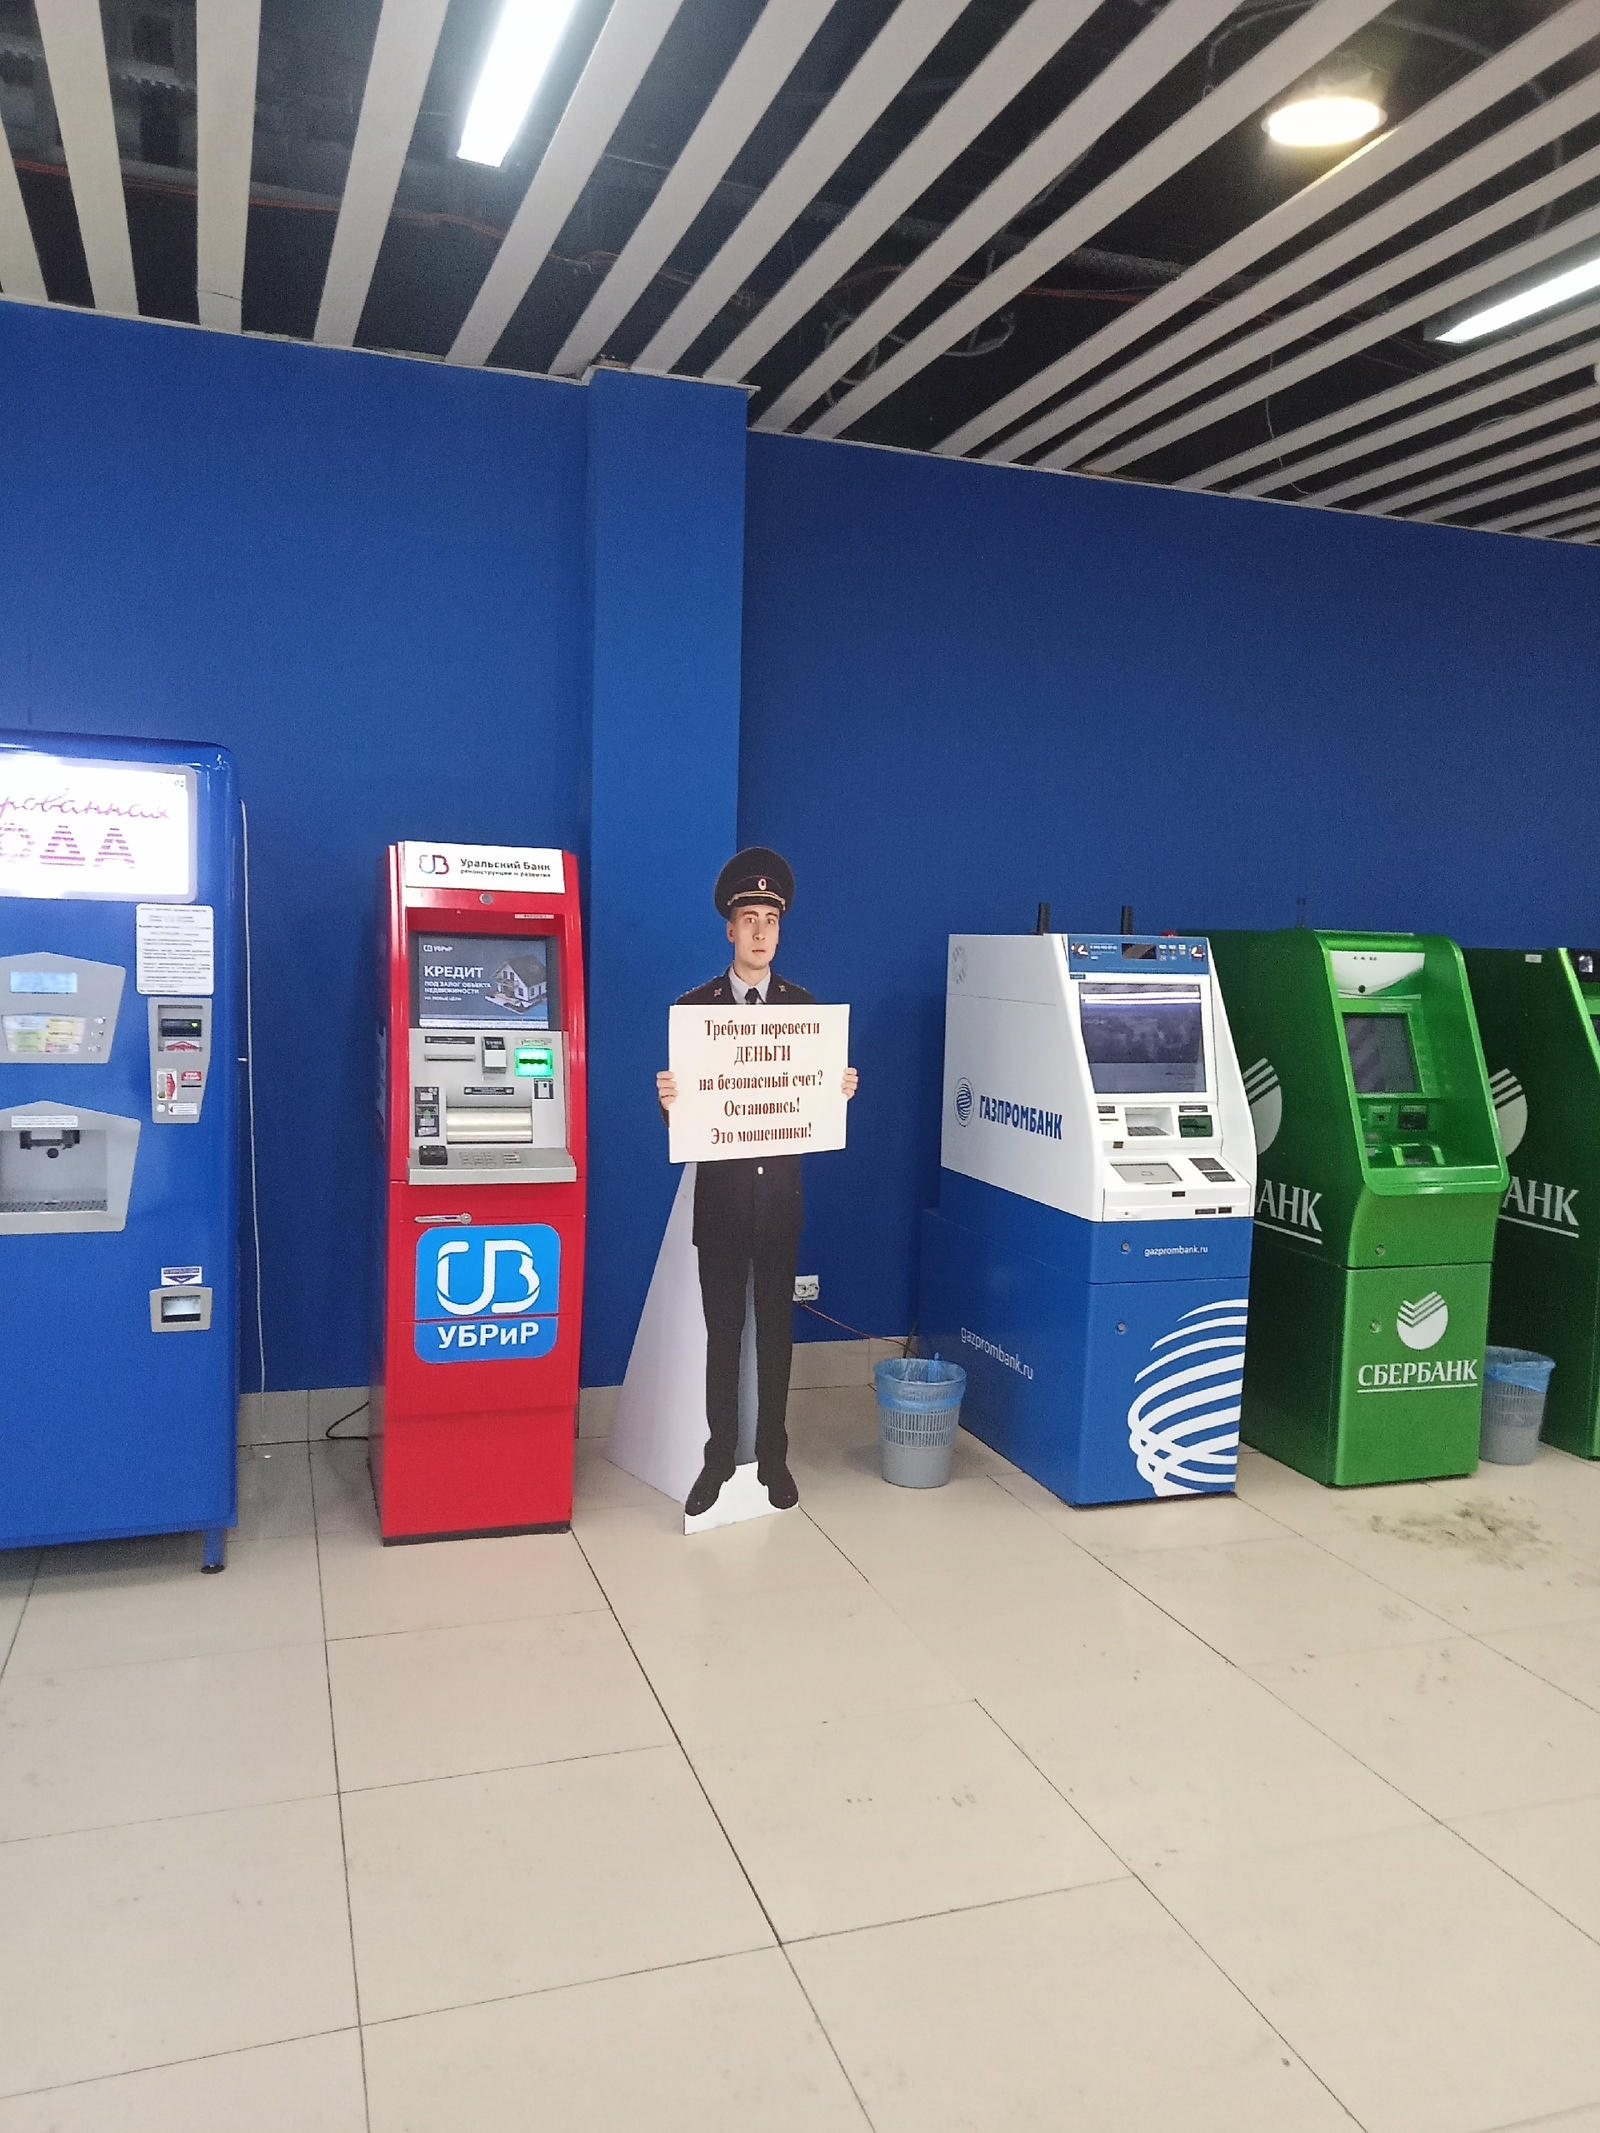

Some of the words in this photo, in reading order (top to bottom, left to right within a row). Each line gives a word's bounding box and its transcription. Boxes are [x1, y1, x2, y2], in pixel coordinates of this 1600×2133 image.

[460, 858, 521, 870] Уральский
[523, 861, 551, 871] Банк
[424, 965, 484, 980] КРЕДИТ
[704, 1020, 757, 1041] Требуют
[761, 1022, 820, 1039] перевести
[734, 1045, 791, 1065] ДЕНЬГИ
[699, 1078, 714, 1091] на
[717, 1071, 789, 1091] безопасный
[792, 1069, 823, 1087] счет?
[724, 1097, 801, 1117] Остановись!
[979, 1095, 1062, 1140] ГАЗПРОМБАНК
[710, 1127, 734, 1145] Это
[737, 1122, 812, 1143] мошенники!
[1256, 1179, 1323, 1232] АНК
[1501, 1175, 1580, 1227] АНК
[1144, 1245, 1209, 1258] gazprombank.ru
[437, 1321, 540, 1349] УБРиР
[960, 1326, 1034, 1381] gazprombank.ru
[1357, 1358, 1478, 1387] СБЕРБАНК
